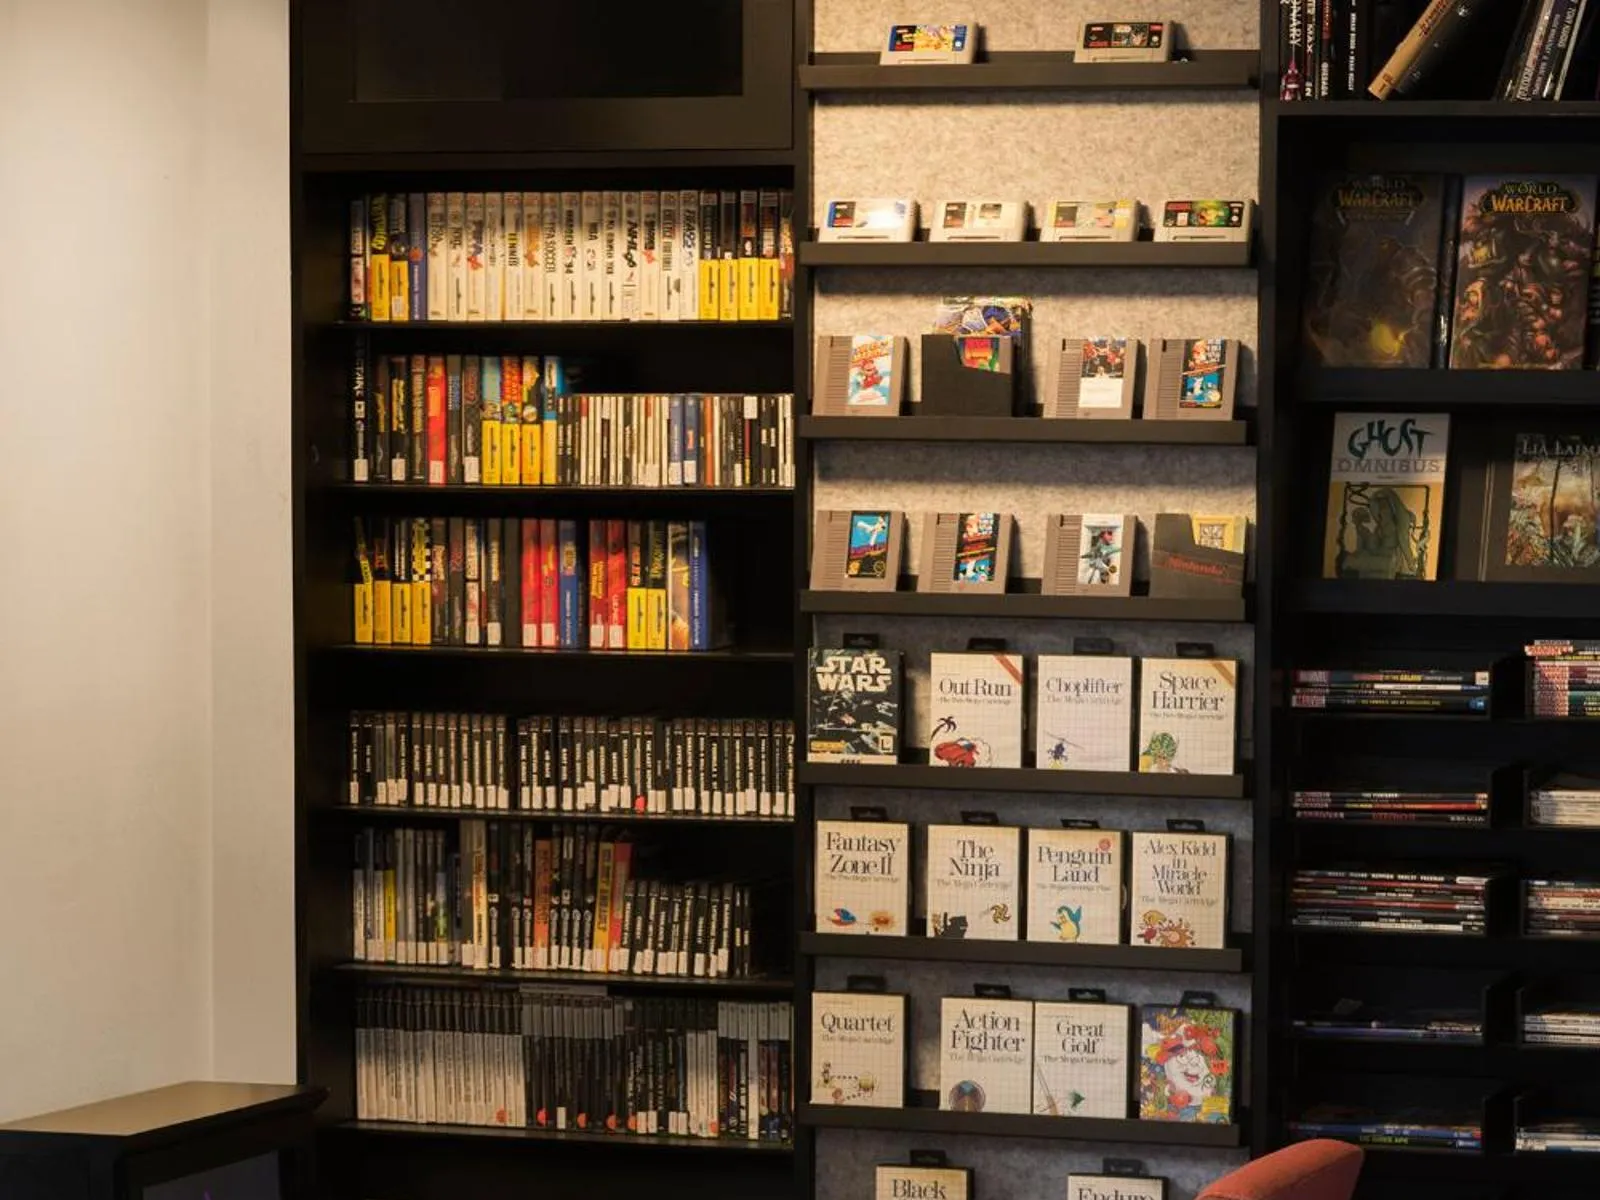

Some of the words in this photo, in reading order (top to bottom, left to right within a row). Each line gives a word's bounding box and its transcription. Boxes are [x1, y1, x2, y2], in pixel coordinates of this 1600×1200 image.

[1504, 182, 1558, 195] WORLD
[1491, 195, 1568, 213] WARCRAFT
[1347, 418, 1434, 460] GHOST
[1337, 458, 1441, 473] OMNIBUS
[816, 656, 892, 674] STAR
[816, 673, 892, 693] WARS
[939, 678, 970, 697] Out
[974, 679, 1012, 698] Run
[1046, 676, 1123, 697] Choplifter
[1158, 670, 1217, 694] Space
[1151, 690, 1224, 712] Harrier
[826, 831, 898, 854] Fantasy
[957, 839, 995, 859] The
[1145, 838, 1178, 856] Alex
[1181, 839, 1217, 857] Kidd
[830, 853, 877, 874] Zone
[1038, 845, 1112, 867] Penguin
[1171, 855, 1188, 869] in
[949, 857, 1001, 882] Ninja
[1052, 864, 1100, 884] Land
[1151, 865, 1208, 881] Miracle
[1157, 879, 1203, 896] World
[821, 1012, 893, 1033] Quartet
[955, 1008, 1020, 1031] Action
[1056, 1020, 1104, 1038] Great
[950, 1029, 1025, 1053] Fighter
[1062, 1037, 1100, 1055] Golf
[892, 1179, 947, 1200] Black
